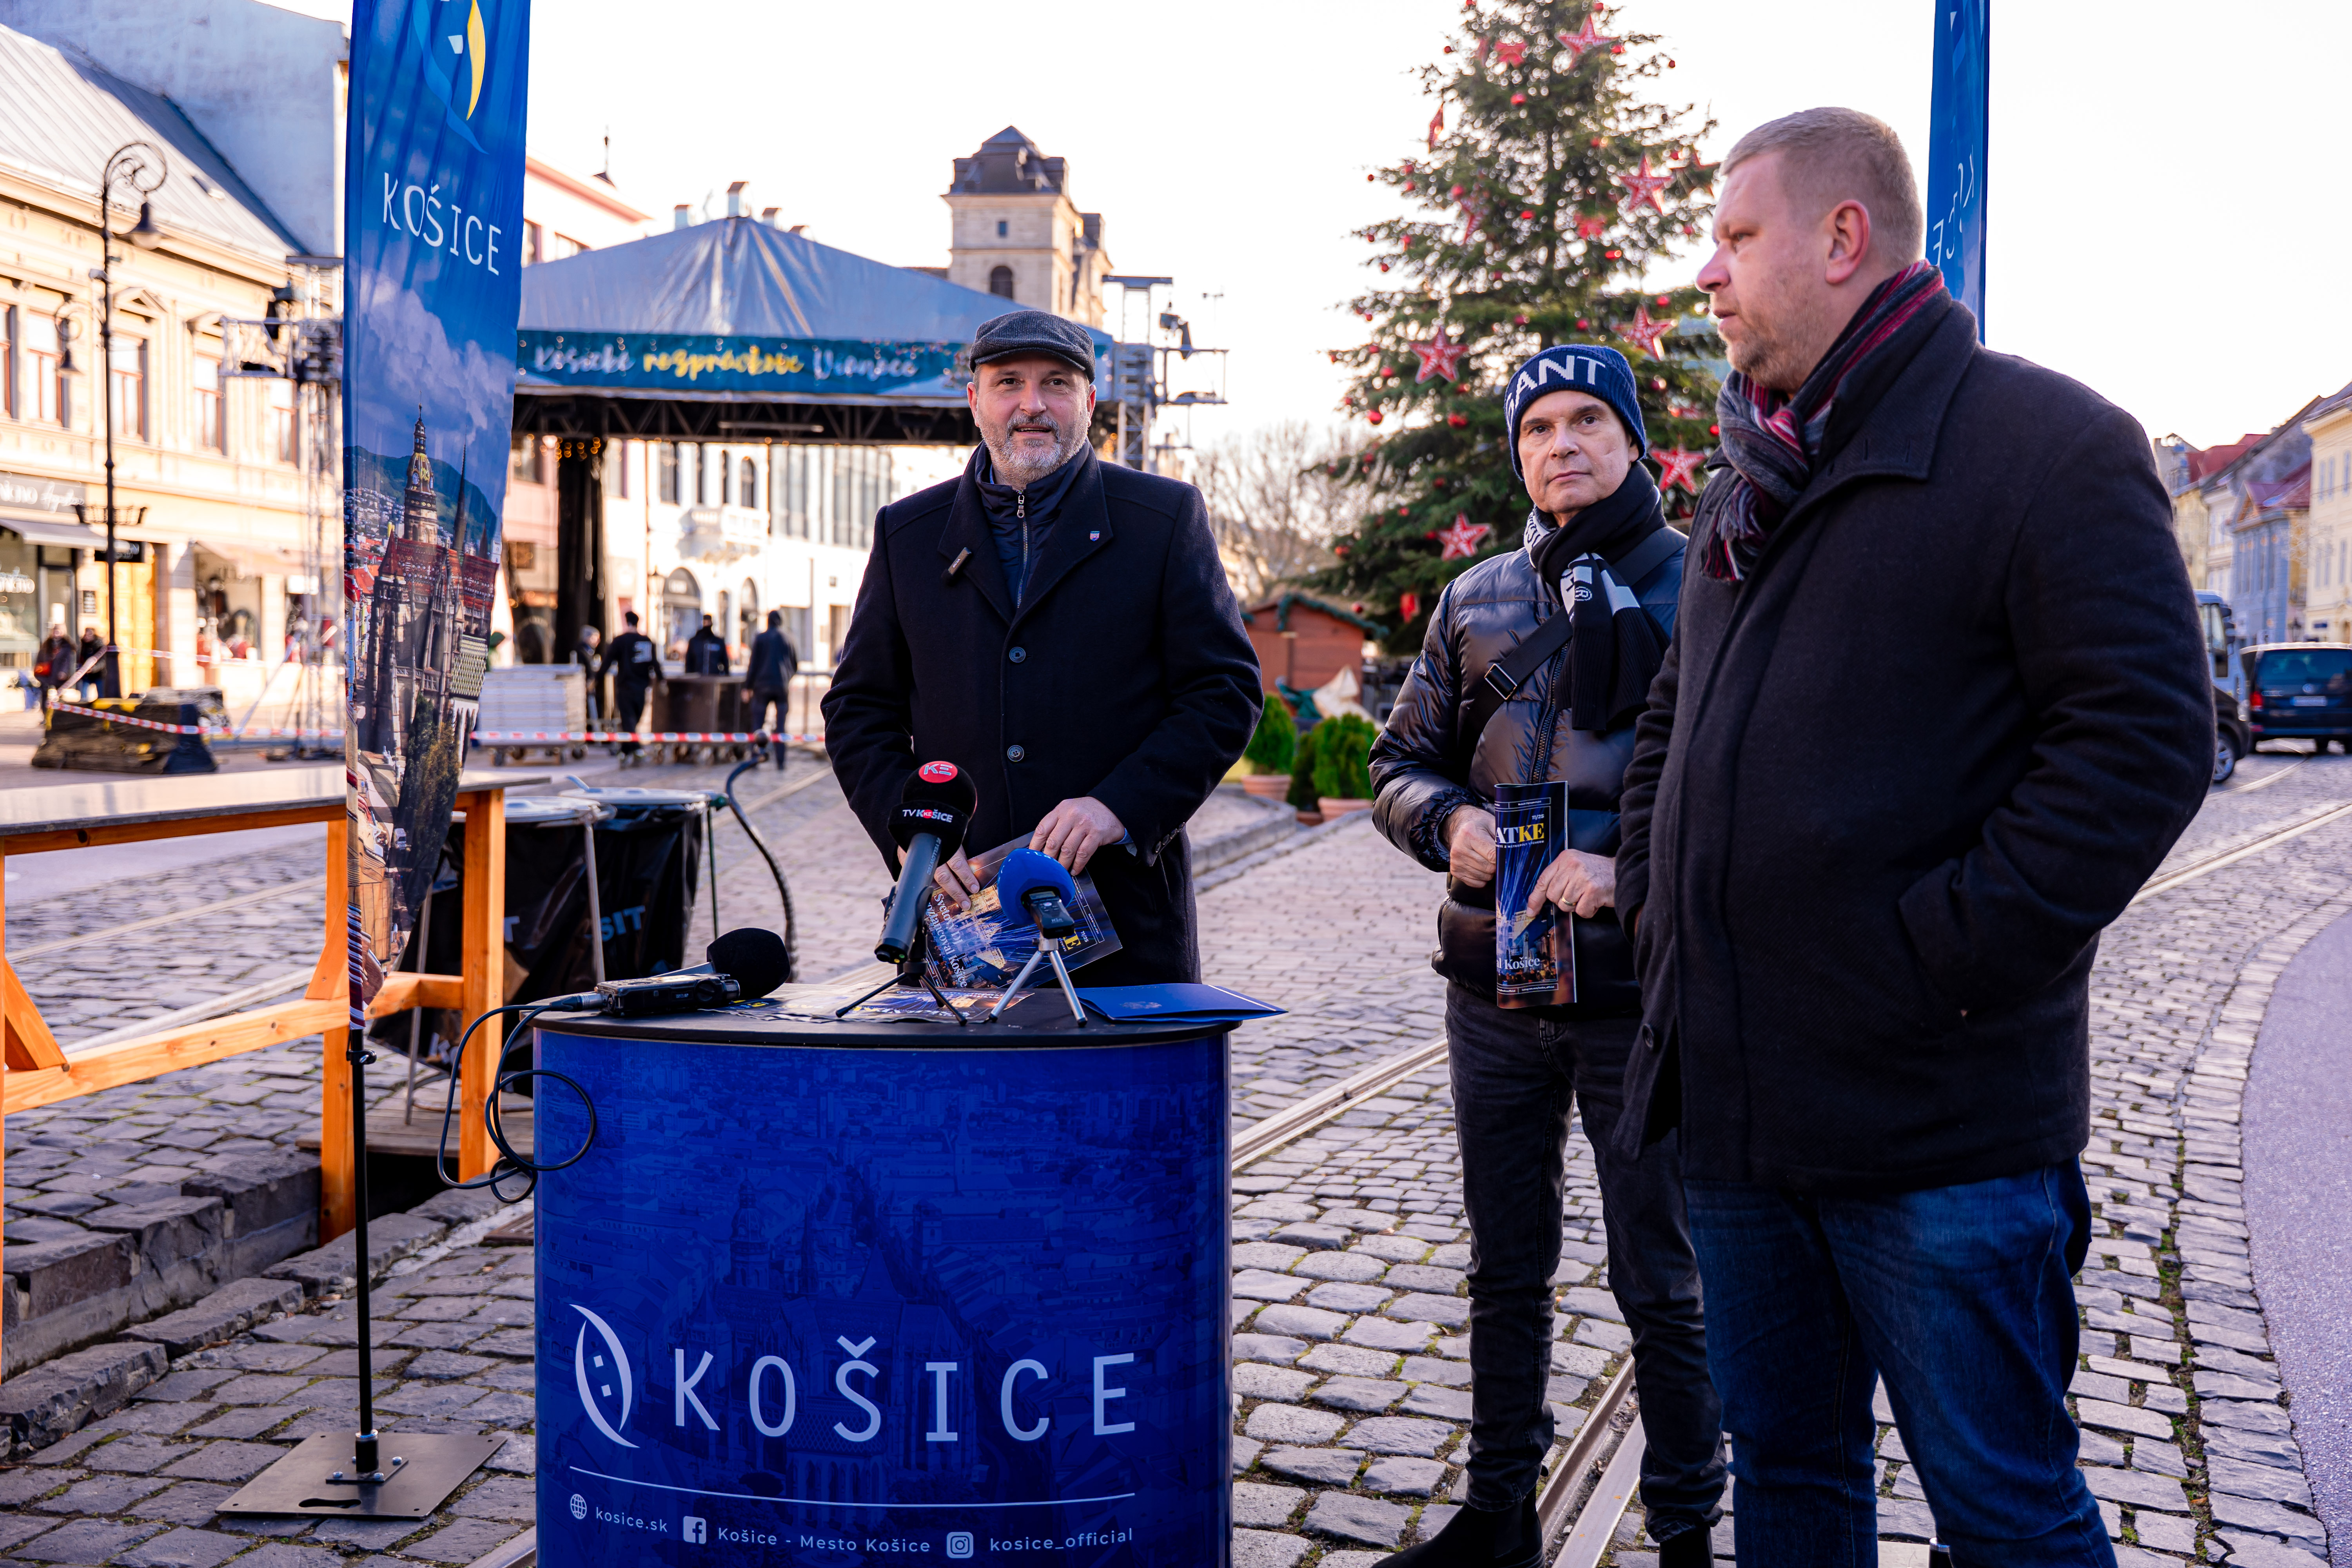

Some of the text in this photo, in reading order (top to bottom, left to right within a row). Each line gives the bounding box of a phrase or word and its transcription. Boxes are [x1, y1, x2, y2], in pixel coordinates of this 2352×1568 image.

[383, 172, 501, 276] KOŠICE
[953, 559, 961, 568] BOYA
[924, 764, 953, 776] KE
[927, 844, 940, 875] YELLOWTEC
[934, 893, 958, 930] Svetový
[926, 902, 967, 988] oztancoval Košice
[1081, 931, 1089, 942] 11/25
[1504, 956, 1540, 969] Košice
[674, 1335, 1135, 1443] KOŠICE
[595, 1507, 668, 1532] kosice.sk
[718, 1527, 777, 1545] Košice
[800, 1535, 857, 1551] Mesto
[866, 1539, 930, 1552] Košice
[990, 1528, 1132, 1551] kosice_official
